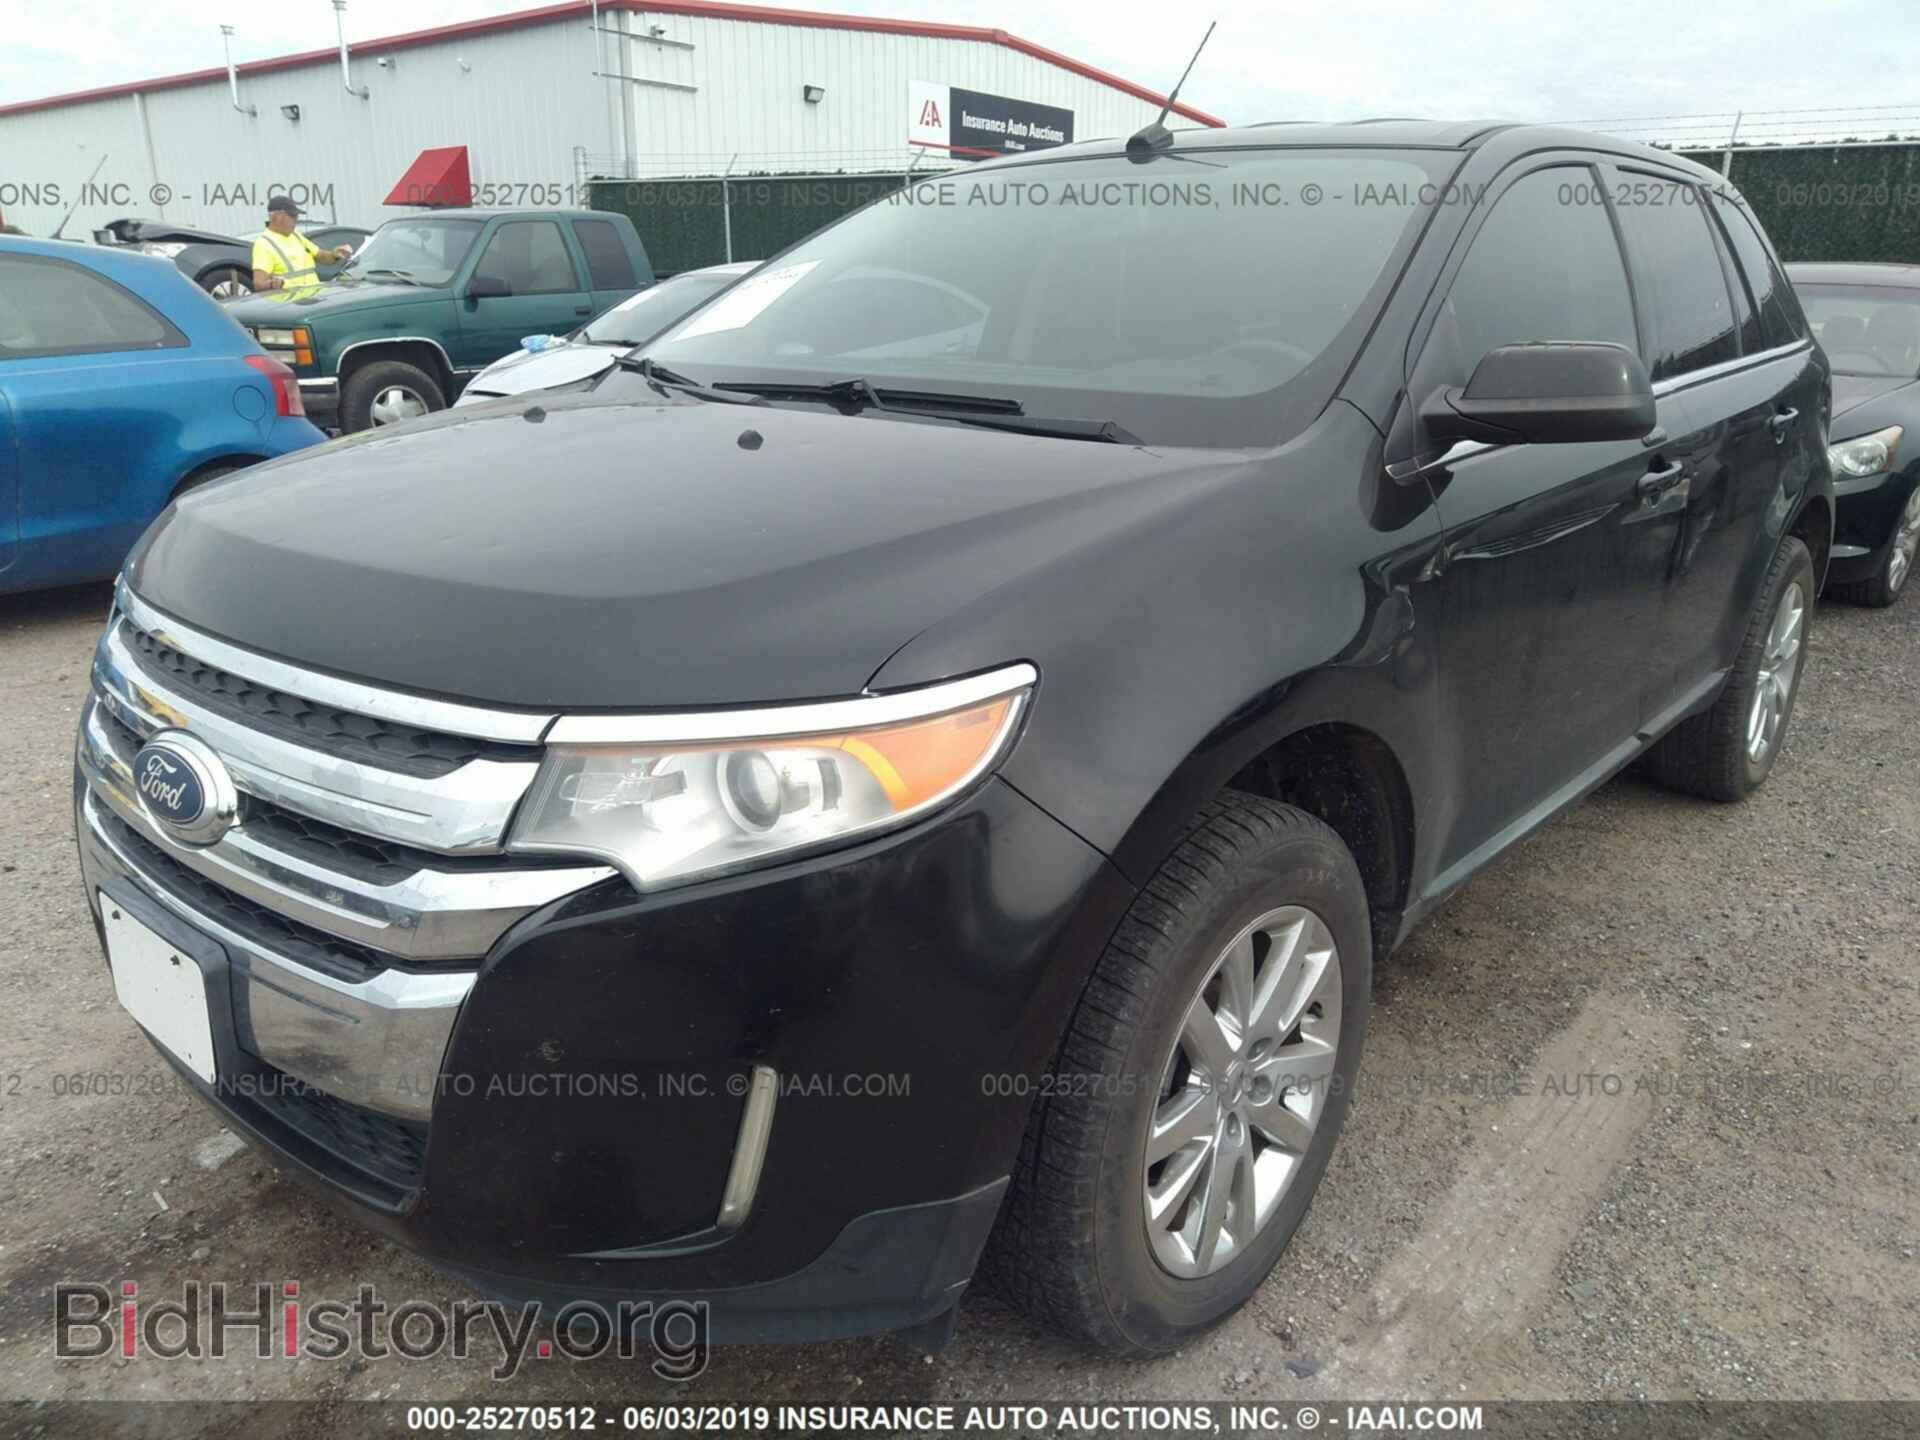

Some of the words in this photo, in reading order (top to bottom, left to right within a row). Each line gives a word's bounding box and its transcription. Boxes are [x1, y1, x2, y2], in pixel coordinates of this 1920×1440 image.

[962, 110, 1006, 133] Insurance
[1005, 118, 1028, 138] Auto
[1028, 122, 1065, 143] Auctions
[140, 755, 187, 811] Ford
